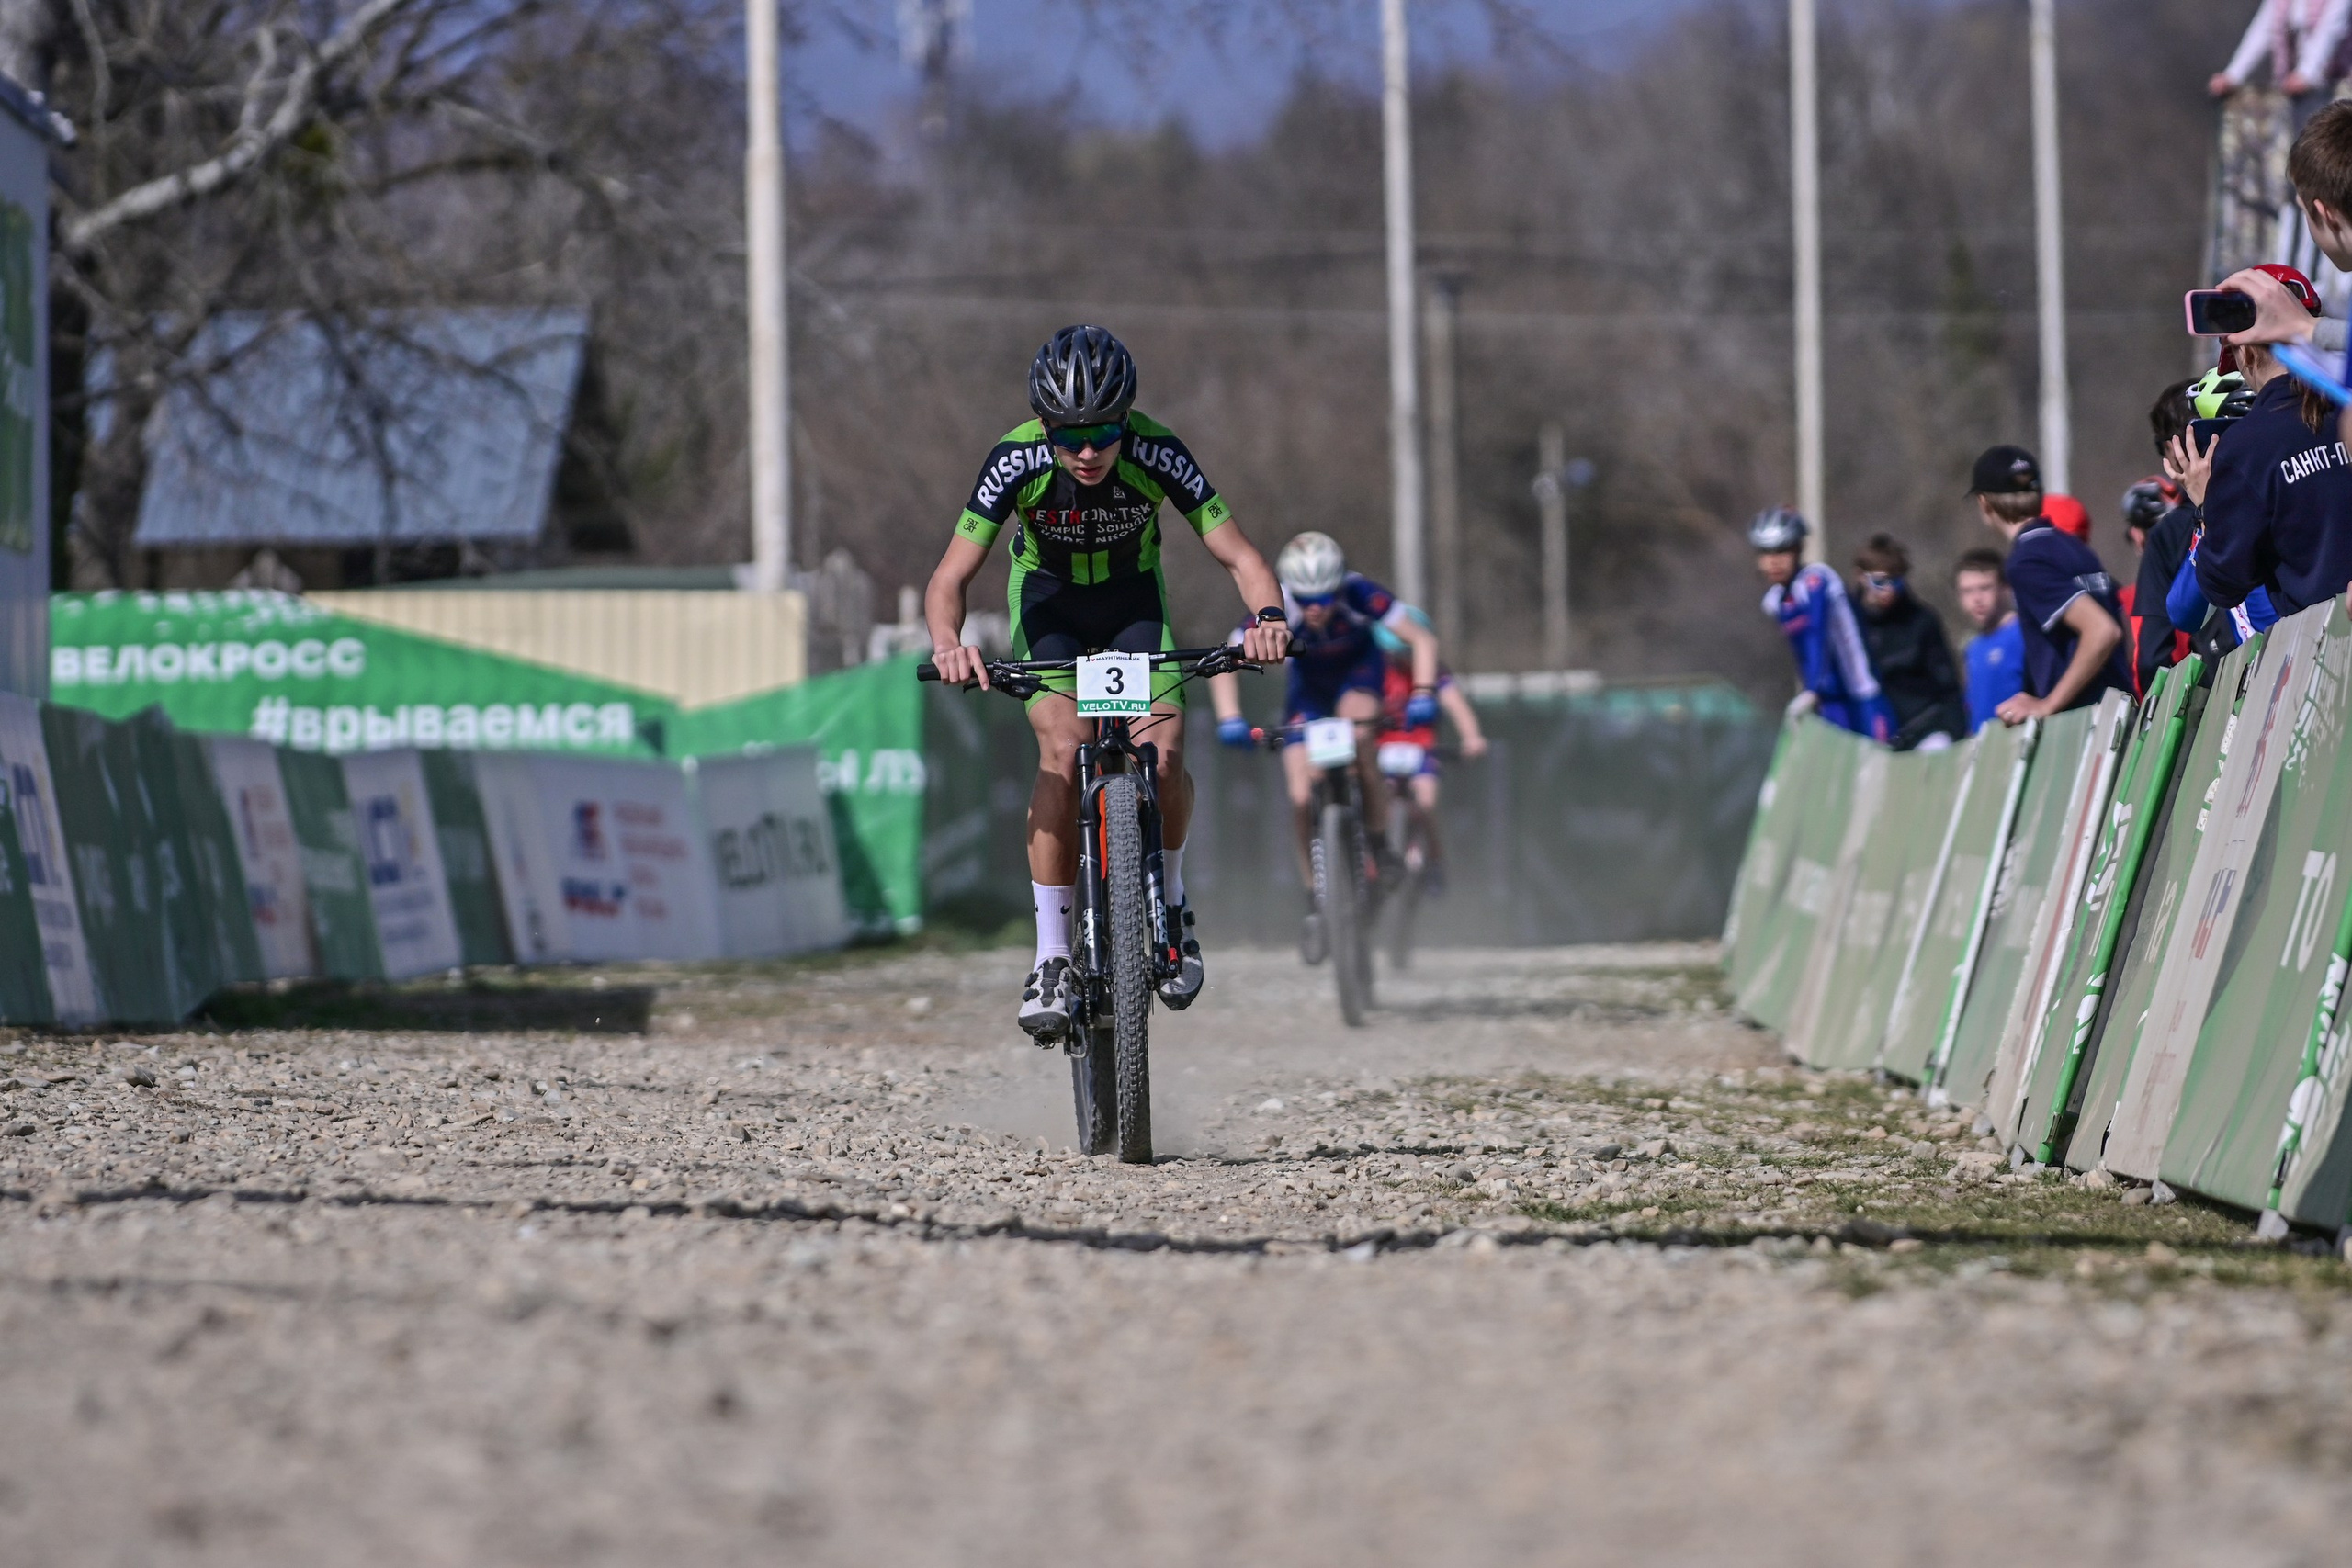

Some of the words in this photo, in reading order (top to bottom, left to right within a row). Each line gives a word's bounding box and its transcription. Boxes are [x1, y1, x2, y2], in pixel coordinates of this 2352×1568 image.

[977, 444, 1054, 509] RUSSIA
[1132, 435, 1205, 500] RUSSIA
[2280, 441, 2352, 484] САНКТ-П
[963, 523, 977, 533] CAT
[966, 517, 980, 526] FAT
[51, 637, 365, 684] ВЕЛОКРОСС
[1105, 667, 1125, 694] 3
[250, 695, 635, 755] #врываемся
